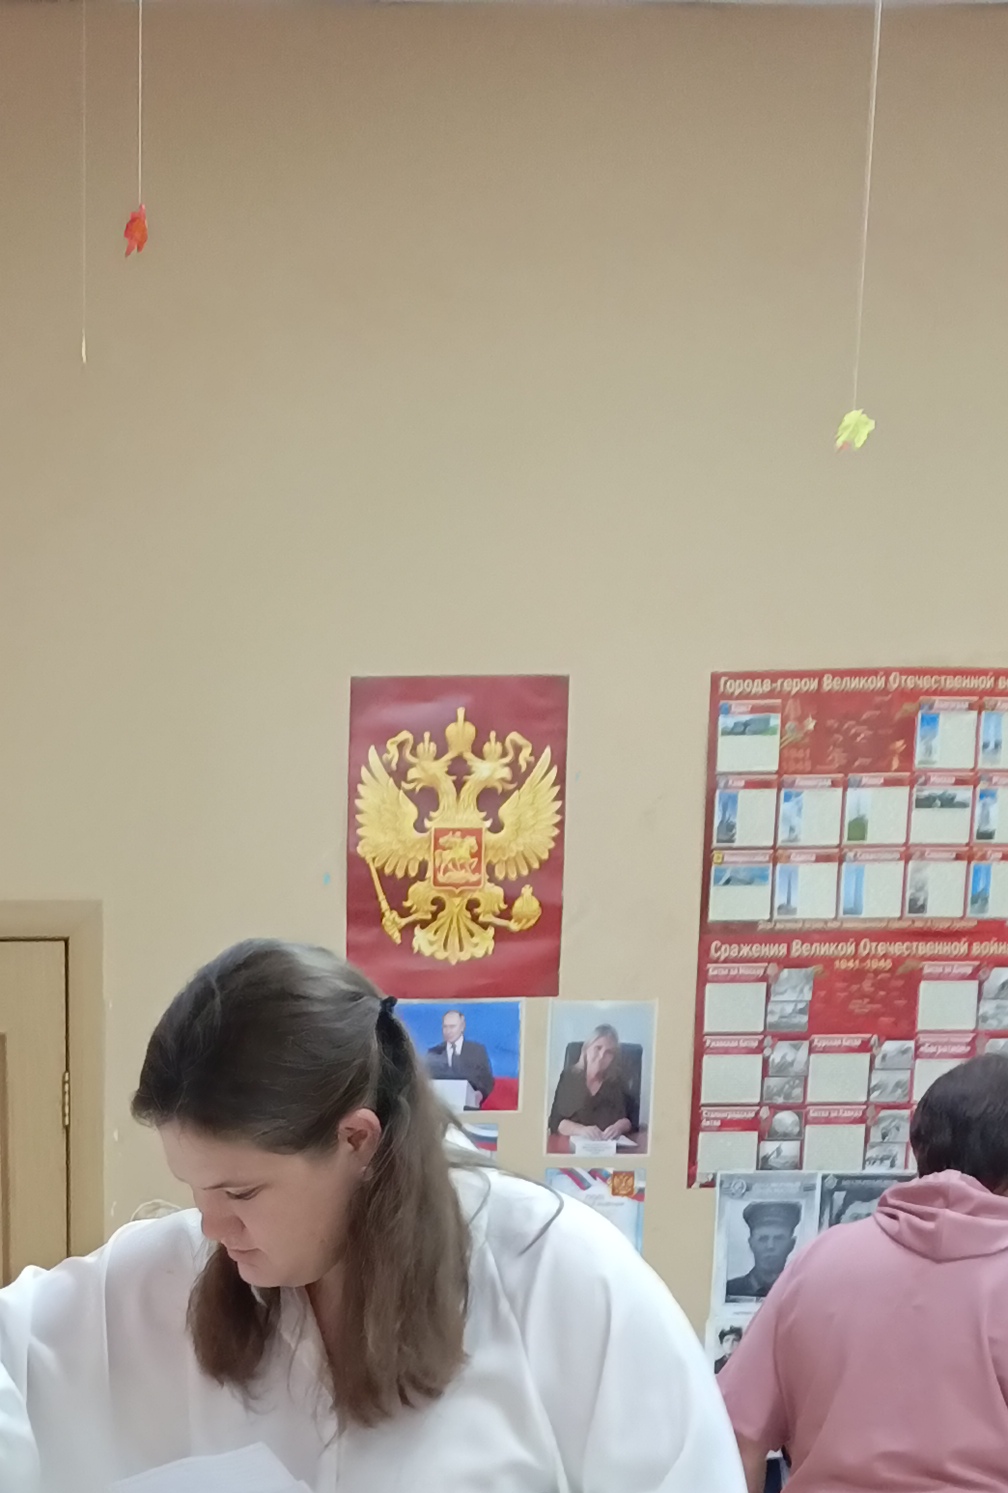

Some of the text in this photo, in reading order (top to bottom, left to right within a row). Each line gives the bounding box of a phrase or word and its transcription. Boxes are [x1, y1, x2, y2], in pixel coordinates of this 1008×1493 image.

[719, 676, 820, 696] Города-герои
[822, 671, 886, 693] Великой
[890, 671, 995, 693] Отечественной
[710, 939, 788, 960] Сражения
[791, 937, 856, 957] Великой
[858, 937, 969, 957] Отечественной
